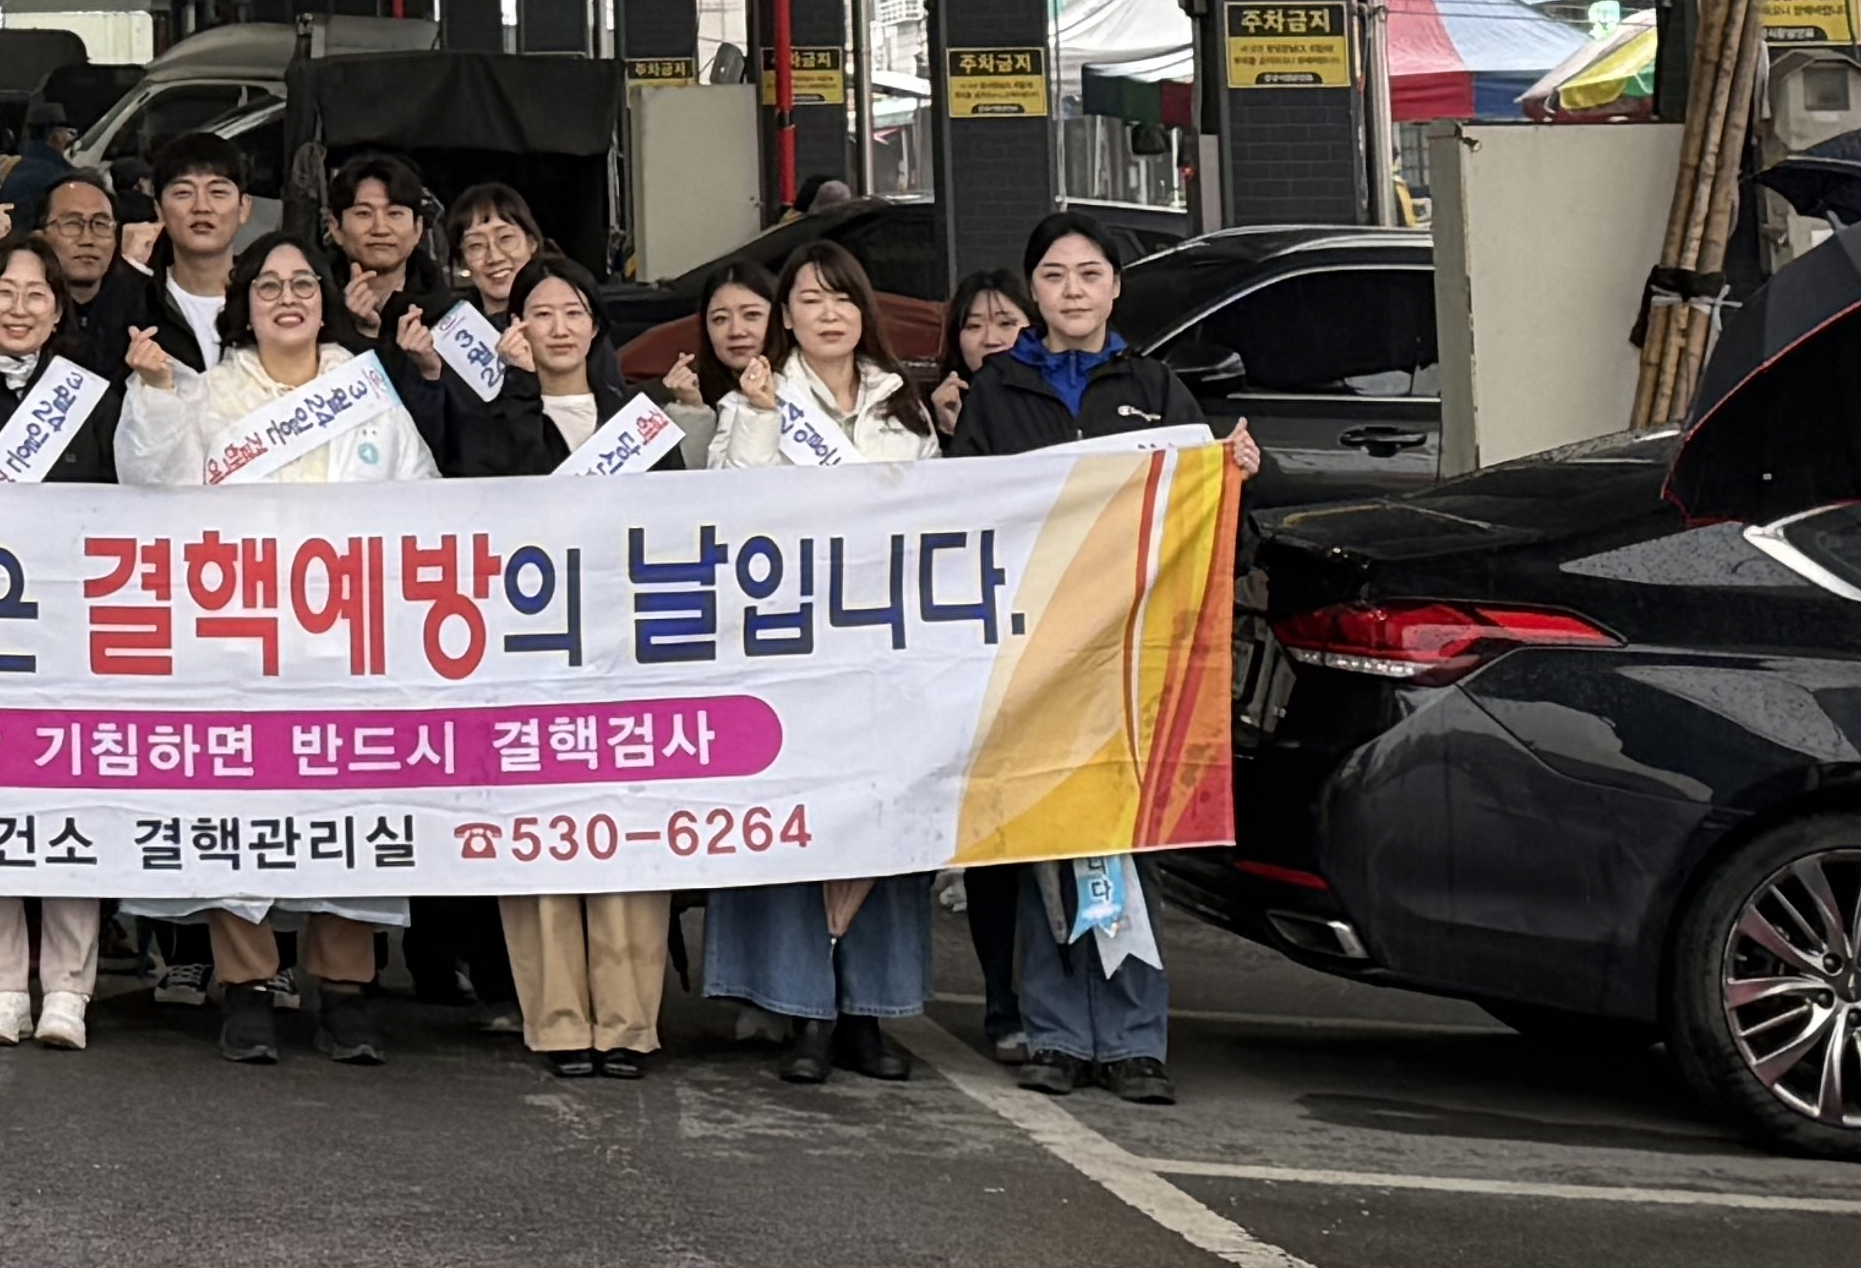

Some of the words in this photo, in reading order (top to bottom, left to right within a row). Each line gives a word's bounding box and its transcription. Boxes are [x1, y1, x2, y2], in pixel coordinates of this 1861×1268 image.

[1241, 8, 1331, 33] 주차금지
[959, 53, 1031, 73] 주차금지
[83, 529, 582, 680] 결핵예방의
[628, 525, 1026, 664] 날입니다.
[33, 721, 255, 778] 기침하면
[292, 723, 456, 777] 반드시
[491, 709, 716, 773] 결핵검사
[133, 814, 416, 871] 결핵관리실
[510, 804, 813, 863] 530-6264
